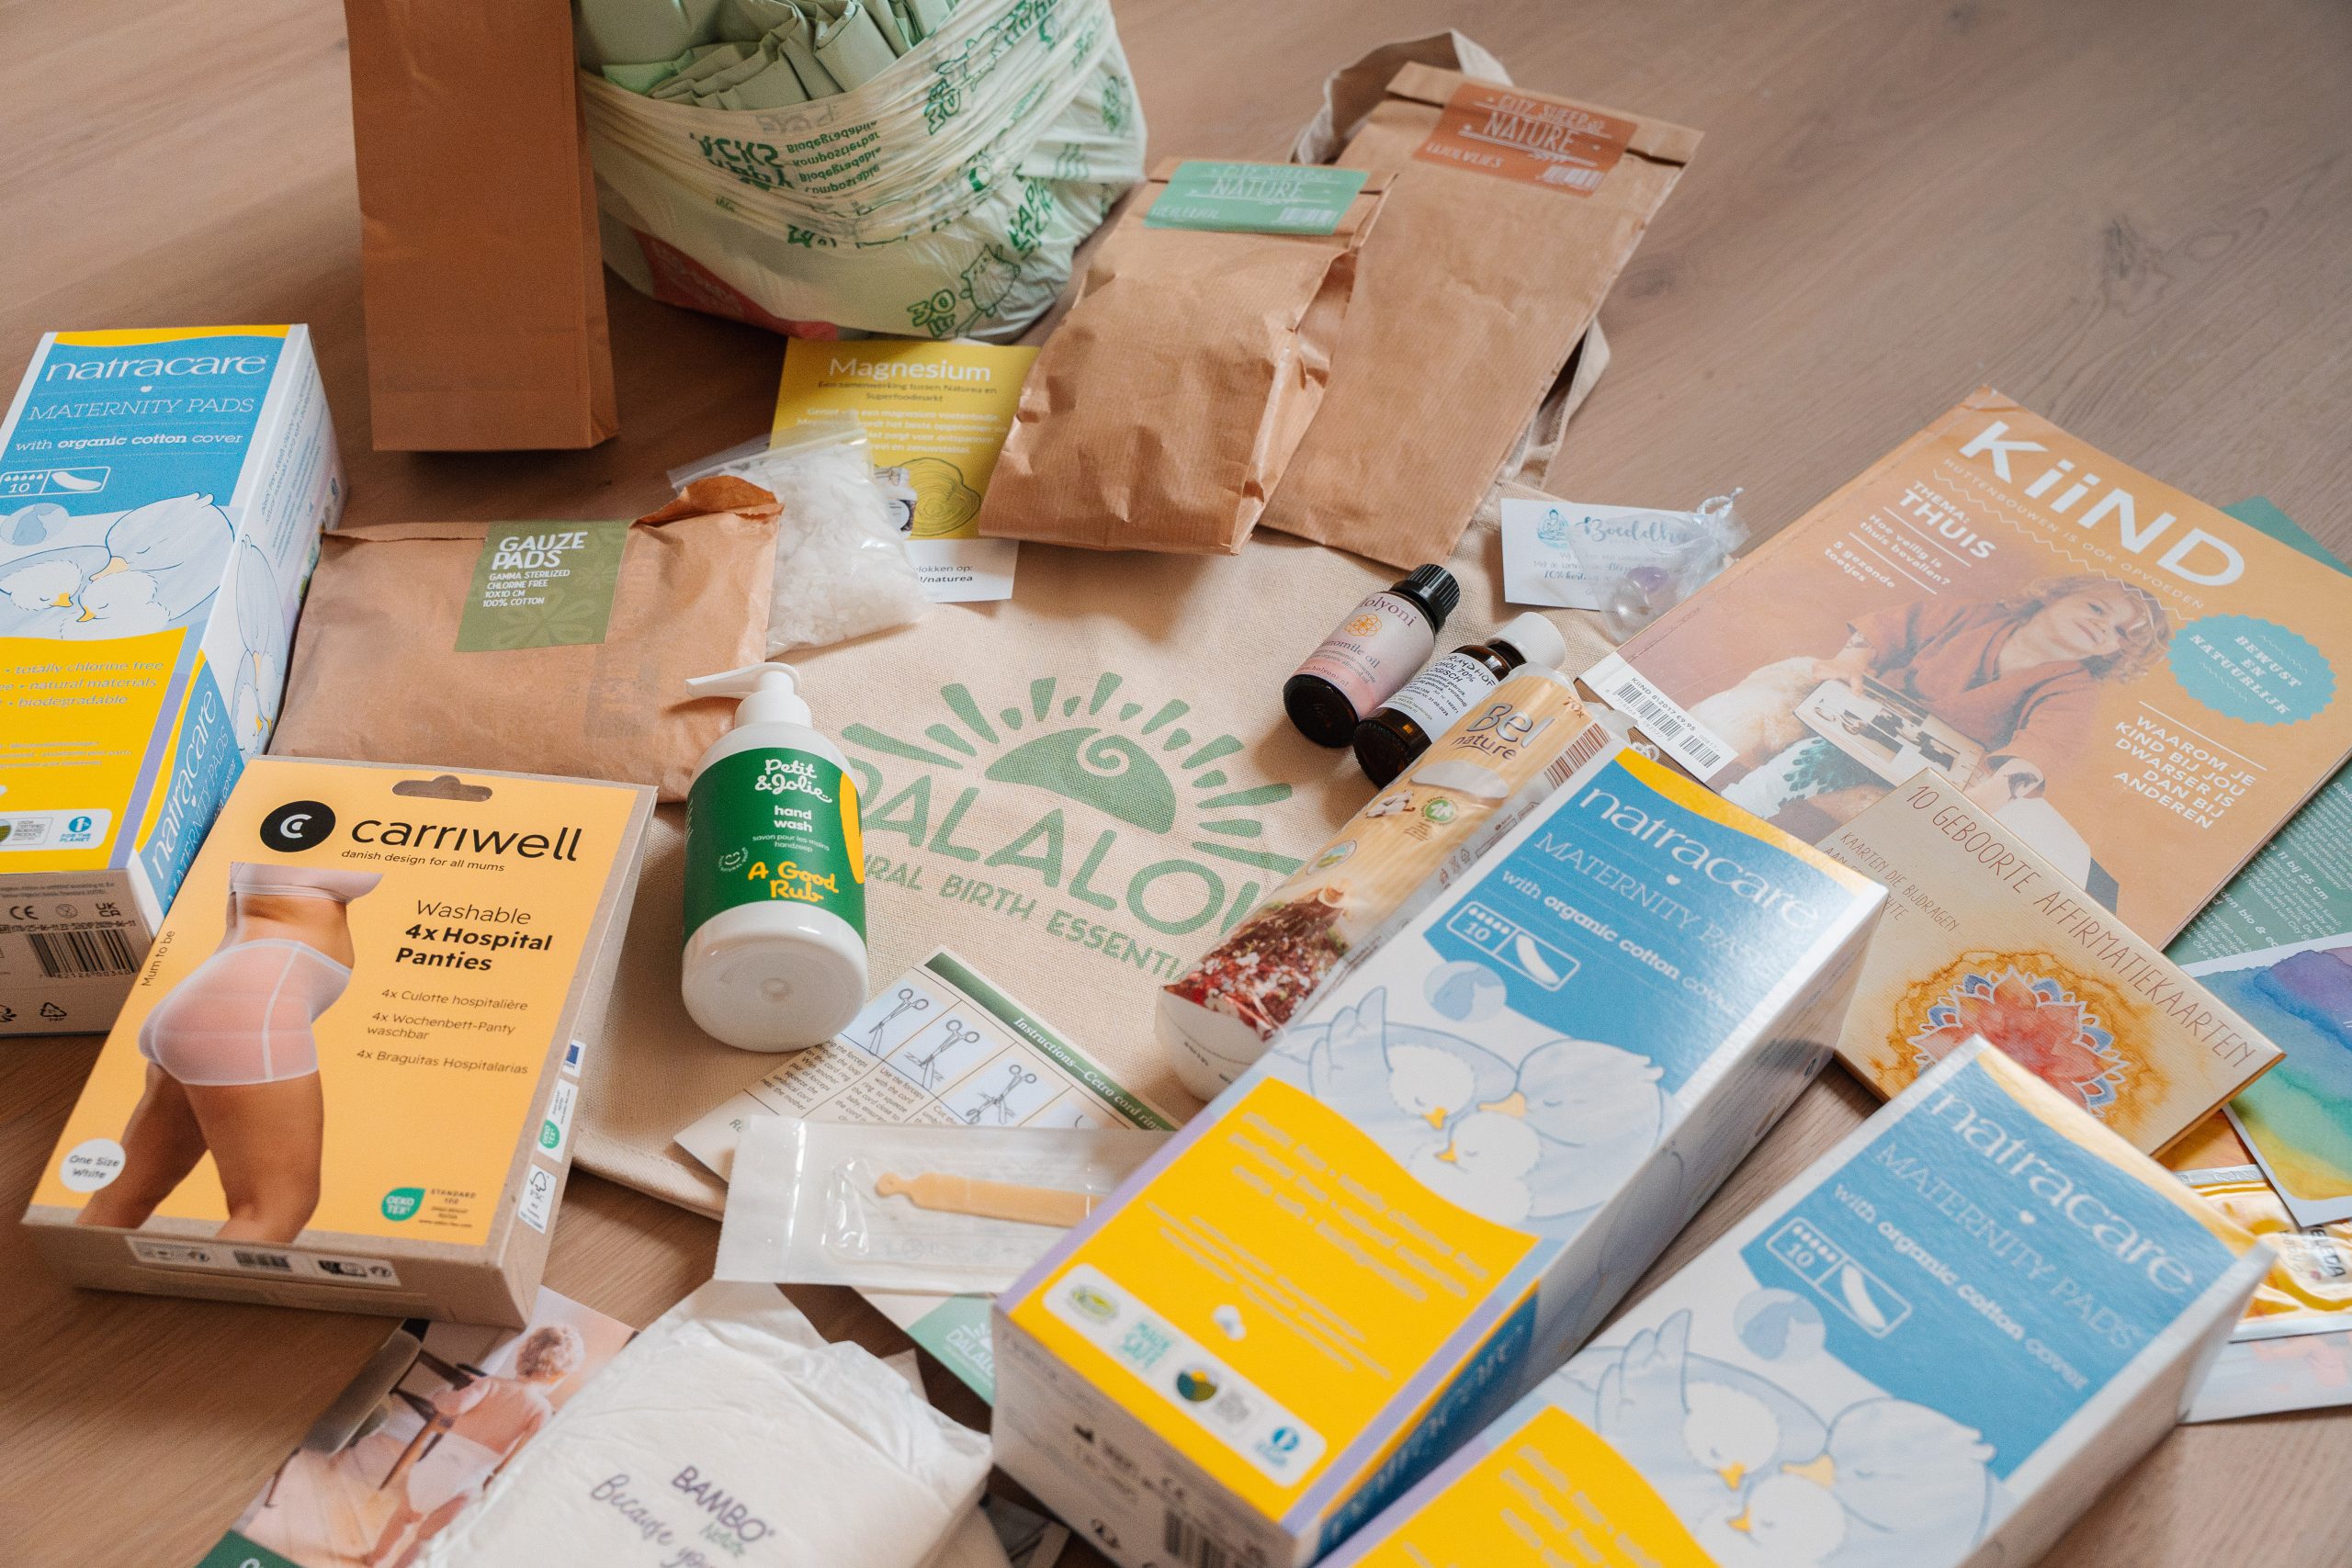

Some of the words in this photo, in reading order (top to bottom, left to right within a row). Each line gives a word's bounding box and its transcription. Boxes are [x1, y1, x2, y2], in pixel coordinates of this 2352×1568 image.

[1482, 110, 1578, 154] NATURE
[1210, 178, 1305, 198] NATURE
[46, 355, 266, 381] natracare
[829, 357, 990, 381] Magnesium
[28, 399, 182, 421] MATERNITY
[187, 398, 254, 413] PADS
[16, 439, 52, 451] with
[58, 434, 127, 450] organic
[132, 433, 187, 446] cotton
[192, 434, 243, 444] cover
[8, 483, 29, 493] 10
[1914, 479, 1971, 525] THEMA:
[1959, 420, 2245, 587] KiiND
[1899, 489, 1997, 559] THUIS
[1944, 457, 2060, 534] HUTTENBOUWEN
[2064, 530, 2079, 544] IS
[2082, 541, 2118, 565] OOK
[2120, 561, 2205, 610] OPVOEDEN
[499, 532, 588, 551] GAUZE
[1860, 522, 1889, 546] thuis
[1891, 544, 1951, 586] bevallen?
[1869, 514, 1894, 535] Hoe
[1895, 534, 1928, 560] veilig
[1930, 558, 1942, 569] is
[492, 550, 562, 570] PADS
[1825, 547, 1866, 581] toetjes
[1834, 541, 1844, 549] 5
[1842, 550, 1895, 589] gezonde
[487, 581, 526, 590] CHLORINE
[528, 580, 548, 588] FREE
[489, 572, 522, 581] GAMMA
[524, 570, 570, 579] STERILIZED
[483, 599, 507, 607] 100%
[510, 598, 545, 606] COTTON
[16, 663, 62, 674] totally
[66, 661, 128, 671] chlorine
[133, 661, 164, 671] free
[1365, 654, 1382, 669] oil
[1458, 666, 1476, 683] 70%
[2189, 634, 2291, 715] NATUURLIJK
[2234, 636, 2302, 687] BEWUST
[2241, 659, 2267, 678] EN
[28, 679, 84, 690] natural
[87, 678, 157, 688] materials
[17, 694, 128, 707] biodegradable
[1469, 702, 1557, 749] Bel
[209, 726, 230, 780] PADS
[1452, 733, 1517, 761] nature
[2115, 721, 2165, 753] KIND
[2169, 752, 2199, 773] BIJ
[2202, 771, 2245, 796] JOU
[2137, 716, 2228, 772] WAAROM
[2230, 770, 2256, 787] JE
[764, 759, 817, 779] Petit
[2115, 738, 2211, 795] DWARSER
[2214, 793, 2235, 808] IS
[152, 690, 216, 879] natracare
[754, 773, 833, 804] &Jolie
[2143, 770, 2188, 799] DAN
[2192, 796, 2224, 818] BIJ
[774, 805, 812, 820] hand
[2114, 772, 2213, 829] ANDEREN
[774, 818, 813, 832] wash
[351, 818, 582, 862] carriwell
[775, 841, 813, 852] handzeep
[777, 834, 796, 842] pour
[797, 835, 808, 844] les
[808, 839, 830, 852] mains
[341, 849, 380, 862] danish
[384, 852, 425, 866] design
[429, 856, 447, 867] for
[450, 858, 464, 868] all
[467, 863, 504, 872] mums
[1578, 785, 1819, 929] natracare
[747, 861, 769, 880] A
[777, 861, 839, 894] Good
[1534, 832, 1700, 933] MATERNITY
[1839, 831, 1890, 874] KAARTEN
[1884, 870, 1907, 888] DIE
[1902, 884, 1961, 932] BIJDRAGEN
[2298, 870, 2313, 886] 25
[2312, 884, 2328, 901] cm
[770, 879, 824, 903] Rub
[96, 902, 117, 910] UK
[99, 909, 120, 918] CA
[416, 899, 531, 925] Washable
[2237, 908, 2256, 925] bio
[405, 923, 436, 941] 4x
[442, 927, 552, 951] Hospital
[941, 874, 1036, 920] BIRTH
[1046, 910, 1189, 981] ESSENTI
[1464, 921, 1492, 942] 10
[1501, 869, 1543, 899] with
[1544, 893, 1619, 944] organic
[1619, 936, 1681, 983] cotton
[1905, 784, 1940, 810] 10
[1932, 805, 2041, 895] GEBOORTE
[2033, 890, 2256, 1069] AFFIRMATIEKAARTEN
[141, 959, 162, 987] Mum
[155, 946, 167, 959] to
[162, 931, 175, 946] be
[395, 947, 492, 972] Panties
[381, 988, 397, 999] 4x
[401, 990, 449, 1005] Culotte
[453, 994, 528, 1011] hospitalière
[368, 1026, 429, 1041] waschbar
[371, 1011, 390, 1023] 4x
[392, 1012, 515, 1036] Wochenbett-Panty
[356, 1049, 373, 1059] 4x
[377, 1051, 438, 1066] Braguitas
[443, 1057, 528, 1075] Hospitalarias
[1114, 1093, 1143, 1118] cord
[70, 1155, 93, 1164] One
[96, 1157, 120, 1167] Size
[74, 1168, 107, 1179] White
[1931, 1090, 2197, 1294] natracare
[1785, 1245, 1815, 1269] 10
[1876, 1142, 2058, 1282] MATERNITY
[2051, 1278, 2146, 1351] PADS
[1834, 1183, 1878, 1225] with
[1878, 1220, 1961, 1288] organic
[1959, 1282, 2026, 1342] cotton
[2025, 1337, 2091, 1392] cover
[590, 1473, 673, 1547] Because
[672, 1465, 768, 1543] BAMBO
